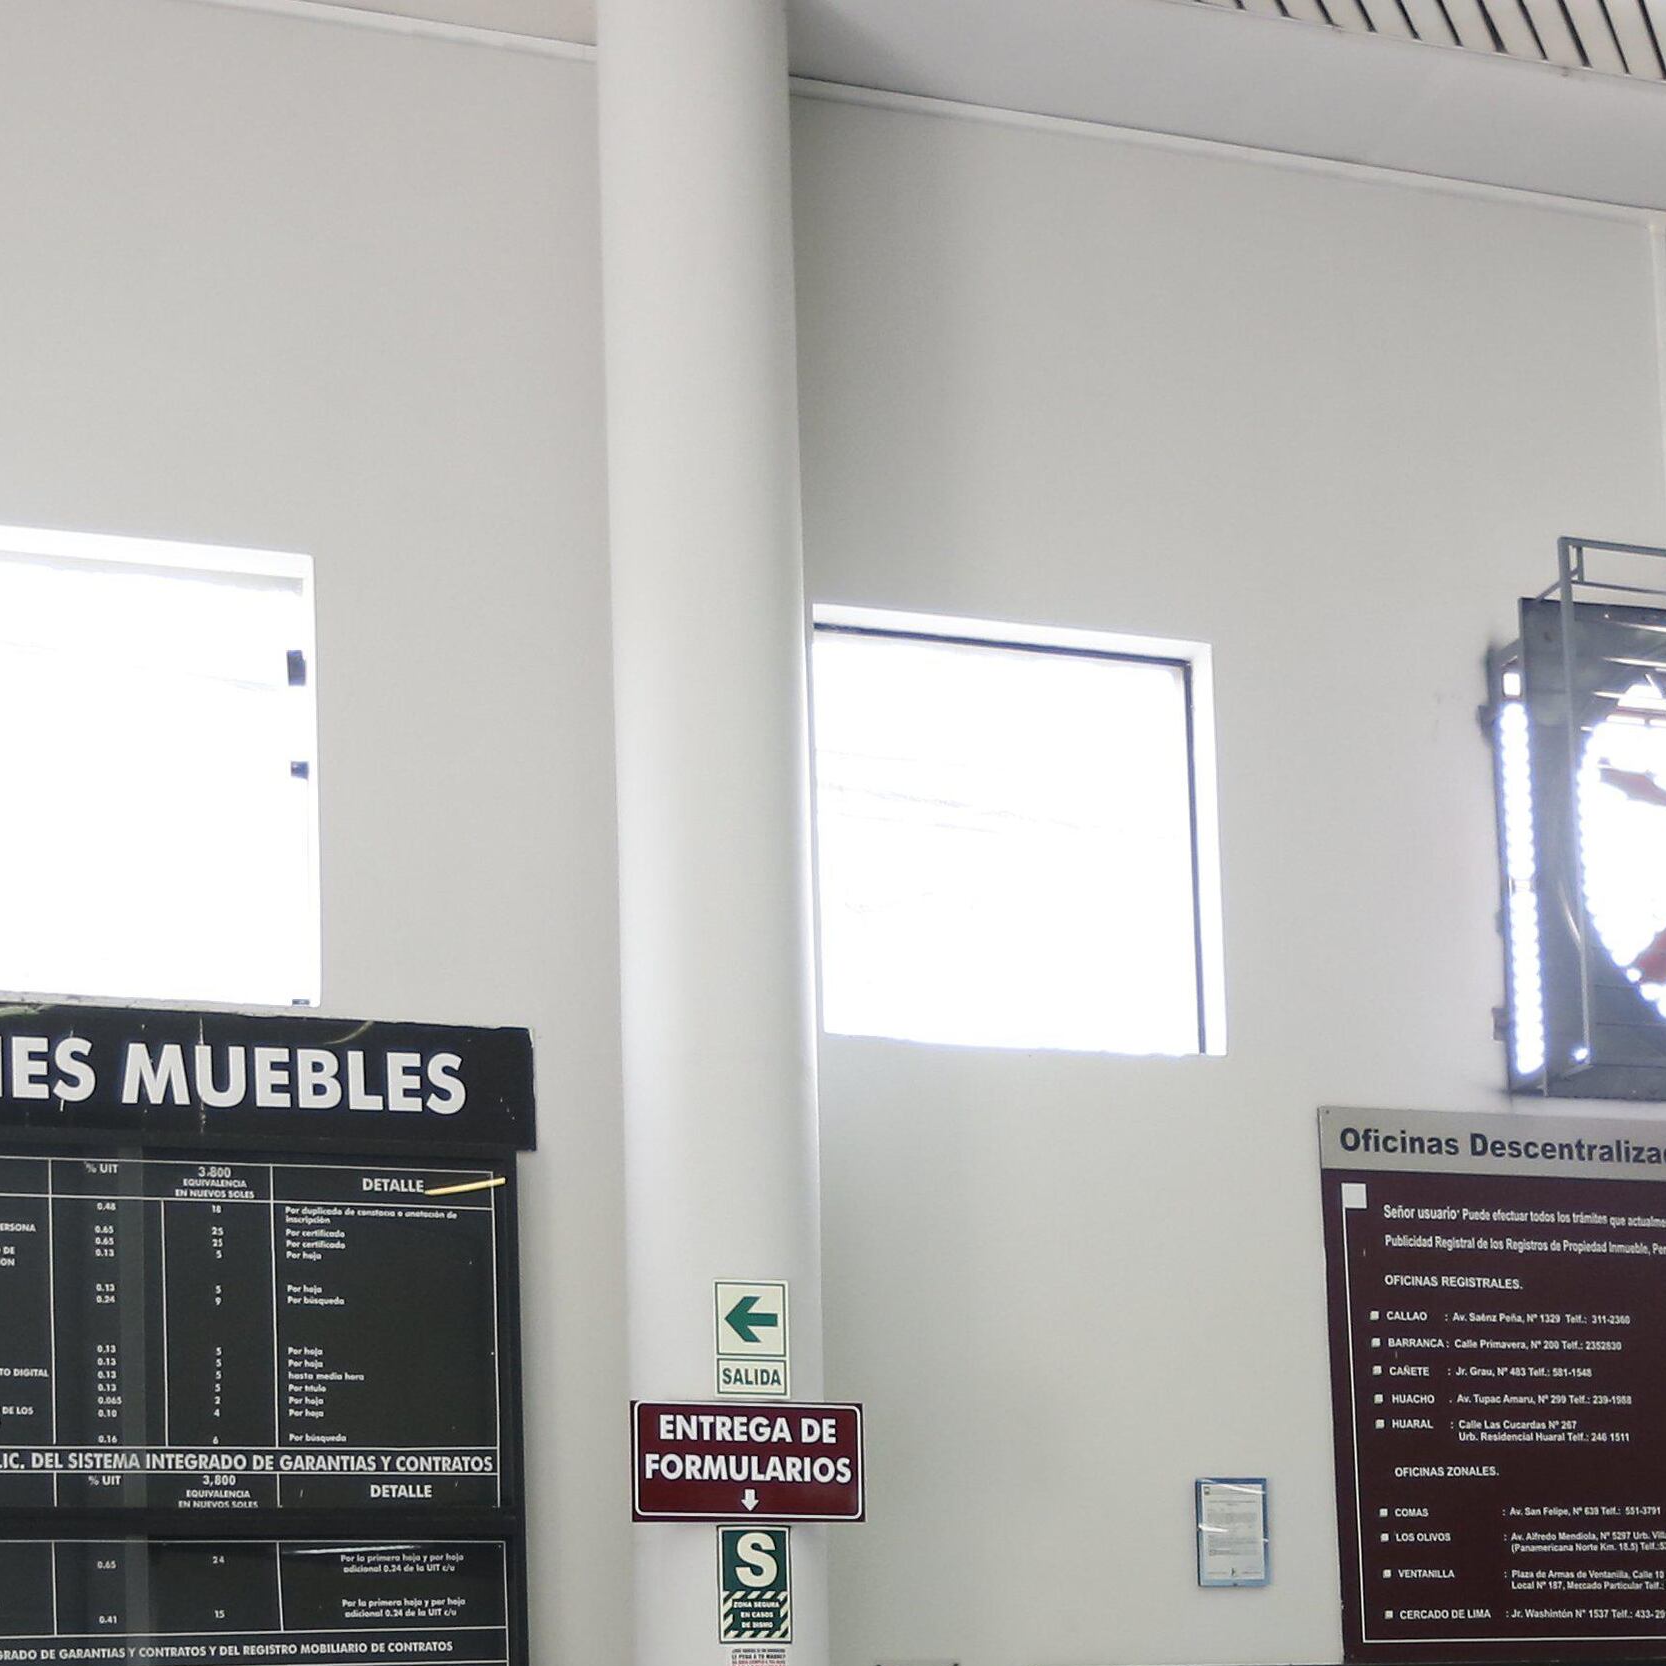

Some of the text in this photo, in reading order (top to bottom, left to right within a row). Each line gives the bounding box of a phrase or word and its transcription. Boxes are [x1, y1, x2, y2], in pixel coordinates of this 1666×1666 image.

[122, 1042, 465, 1114] MUEBLES
[1340, 1127, 1458, 1155] Oficinas
[1384, 1274, 1522, 1288] OFICINAS REGISTRALES.
[1386, 1311, 1427, 1320] CALLAO
[1389, 1366, 1429, 1375] CAÑETE
[721, 1366, 782, 1388] SALIDA
[1392, 1394, 1434, 1403] HUACHO
[660, 1414, 835, 1443] ENTREGA DE
[1392, 1419, 1432, 1428] HUARAL
[31, 1453, 64, 1470] DEL
[68, 1453, 141, 1470] SISTEMA
[146, 1454, 250, 1471] INTEGRADO
[252, 1454, 274, 1470] DE
[279, 1454, 376, 1472] GARANTIAS
[379, 1455, 391, 1471] Y
[395, 1455, 493, 1472] CONTRATOS
[645, 1453, 851, 1482] FORMULARIOS
[1394, 1466, 1498, 1476] OFICINAS ZONALES.
[1395, 1508, 1428, 1516] COMAS
[1395, 1532, 1450, 1541] LOS OLIVOS
[736, 1532, 776, 1586] S
[1398, 1569, 1454, 1577] VENTANILLA
[1399, 1609, 1490, 1619] CERCADO DE LIMA
[40, 1649, 54, 1659] DE
[58, 1647, 124, 1659] GARANTIAS
[128, 1647, 135, 1657] Y
[138, 1646, 206, 1657] CONTRATOS
[209, 1646, 216, 1655] Y
[219, 1645, 240, 1655] DEL
[243, 1644, 297, 1655] REGISTRO
[300, 1642, 367, 1653] MOBILIARIO
[371, 1642, 384, 1652] DE
[387, 1641, 452, 1652] CONTRATOS
